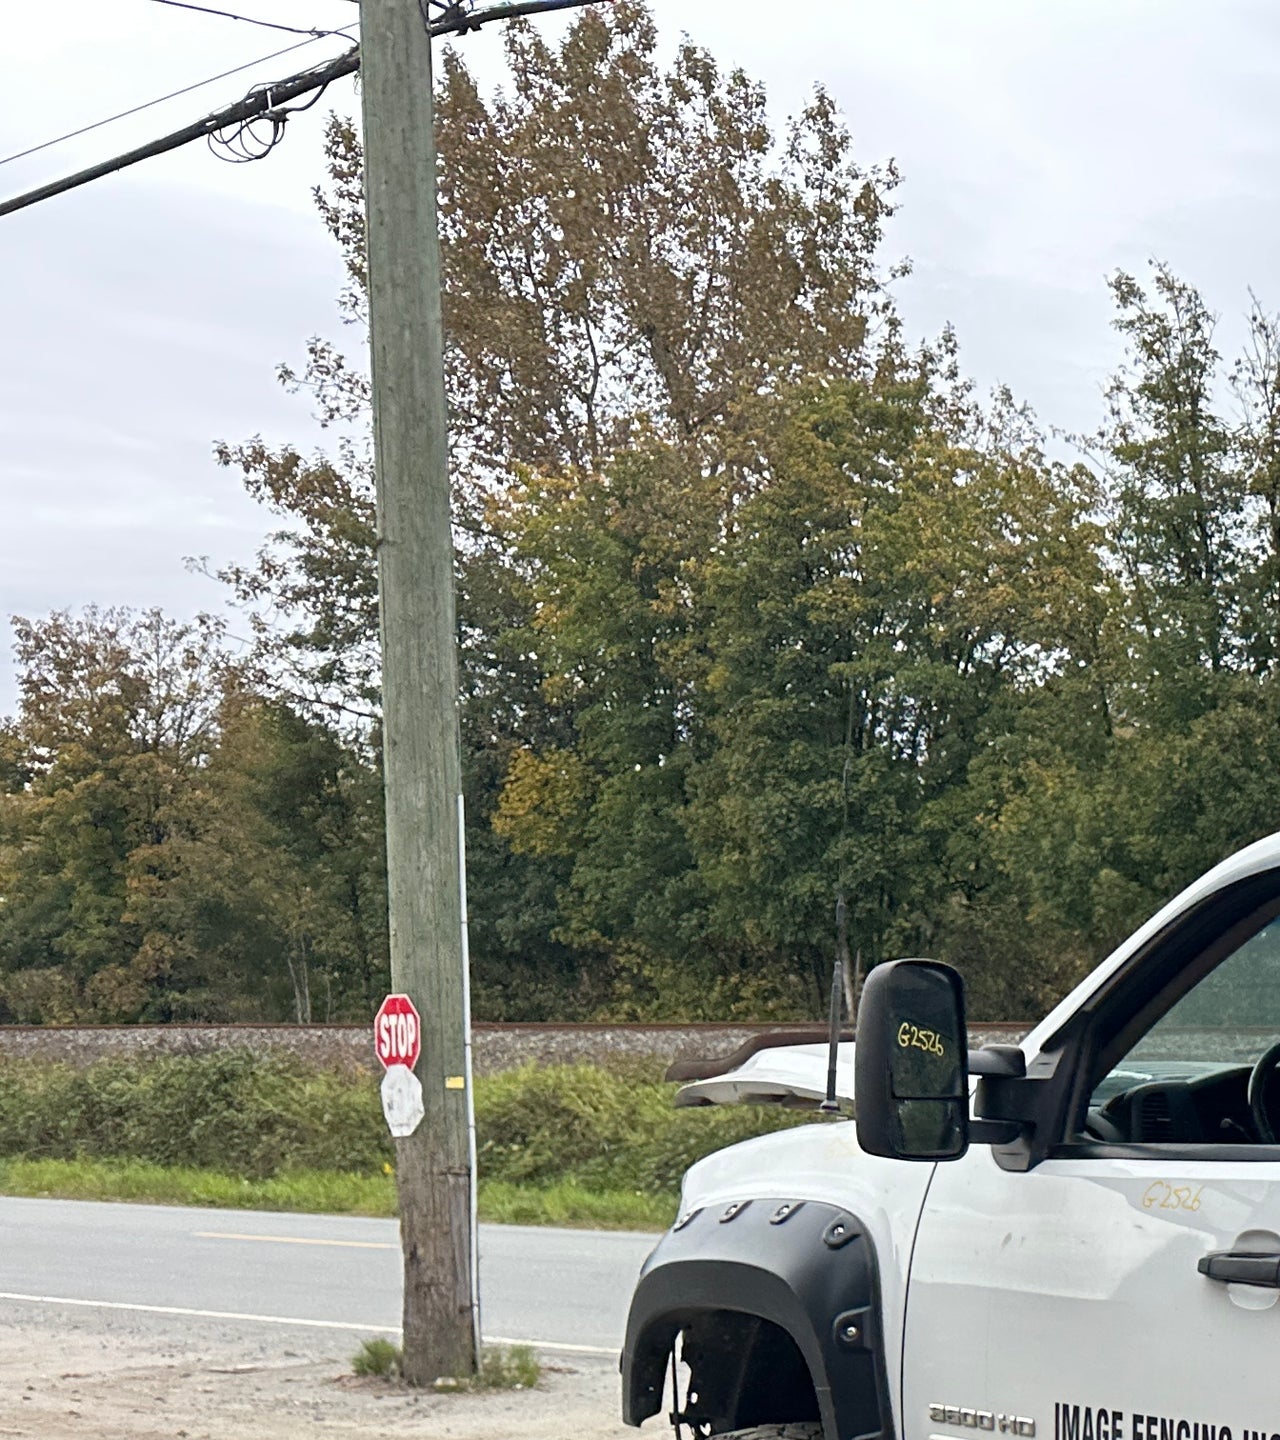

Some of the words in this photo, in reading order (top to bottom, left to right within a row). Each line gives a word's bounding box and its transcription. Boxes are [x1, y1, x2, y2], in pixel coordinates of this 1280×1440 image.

[380, 1013, 416, 1058] STOP
[898, 1022, 944, 1056] G2526
[1142, 1180, 1205, 1211] G2526
